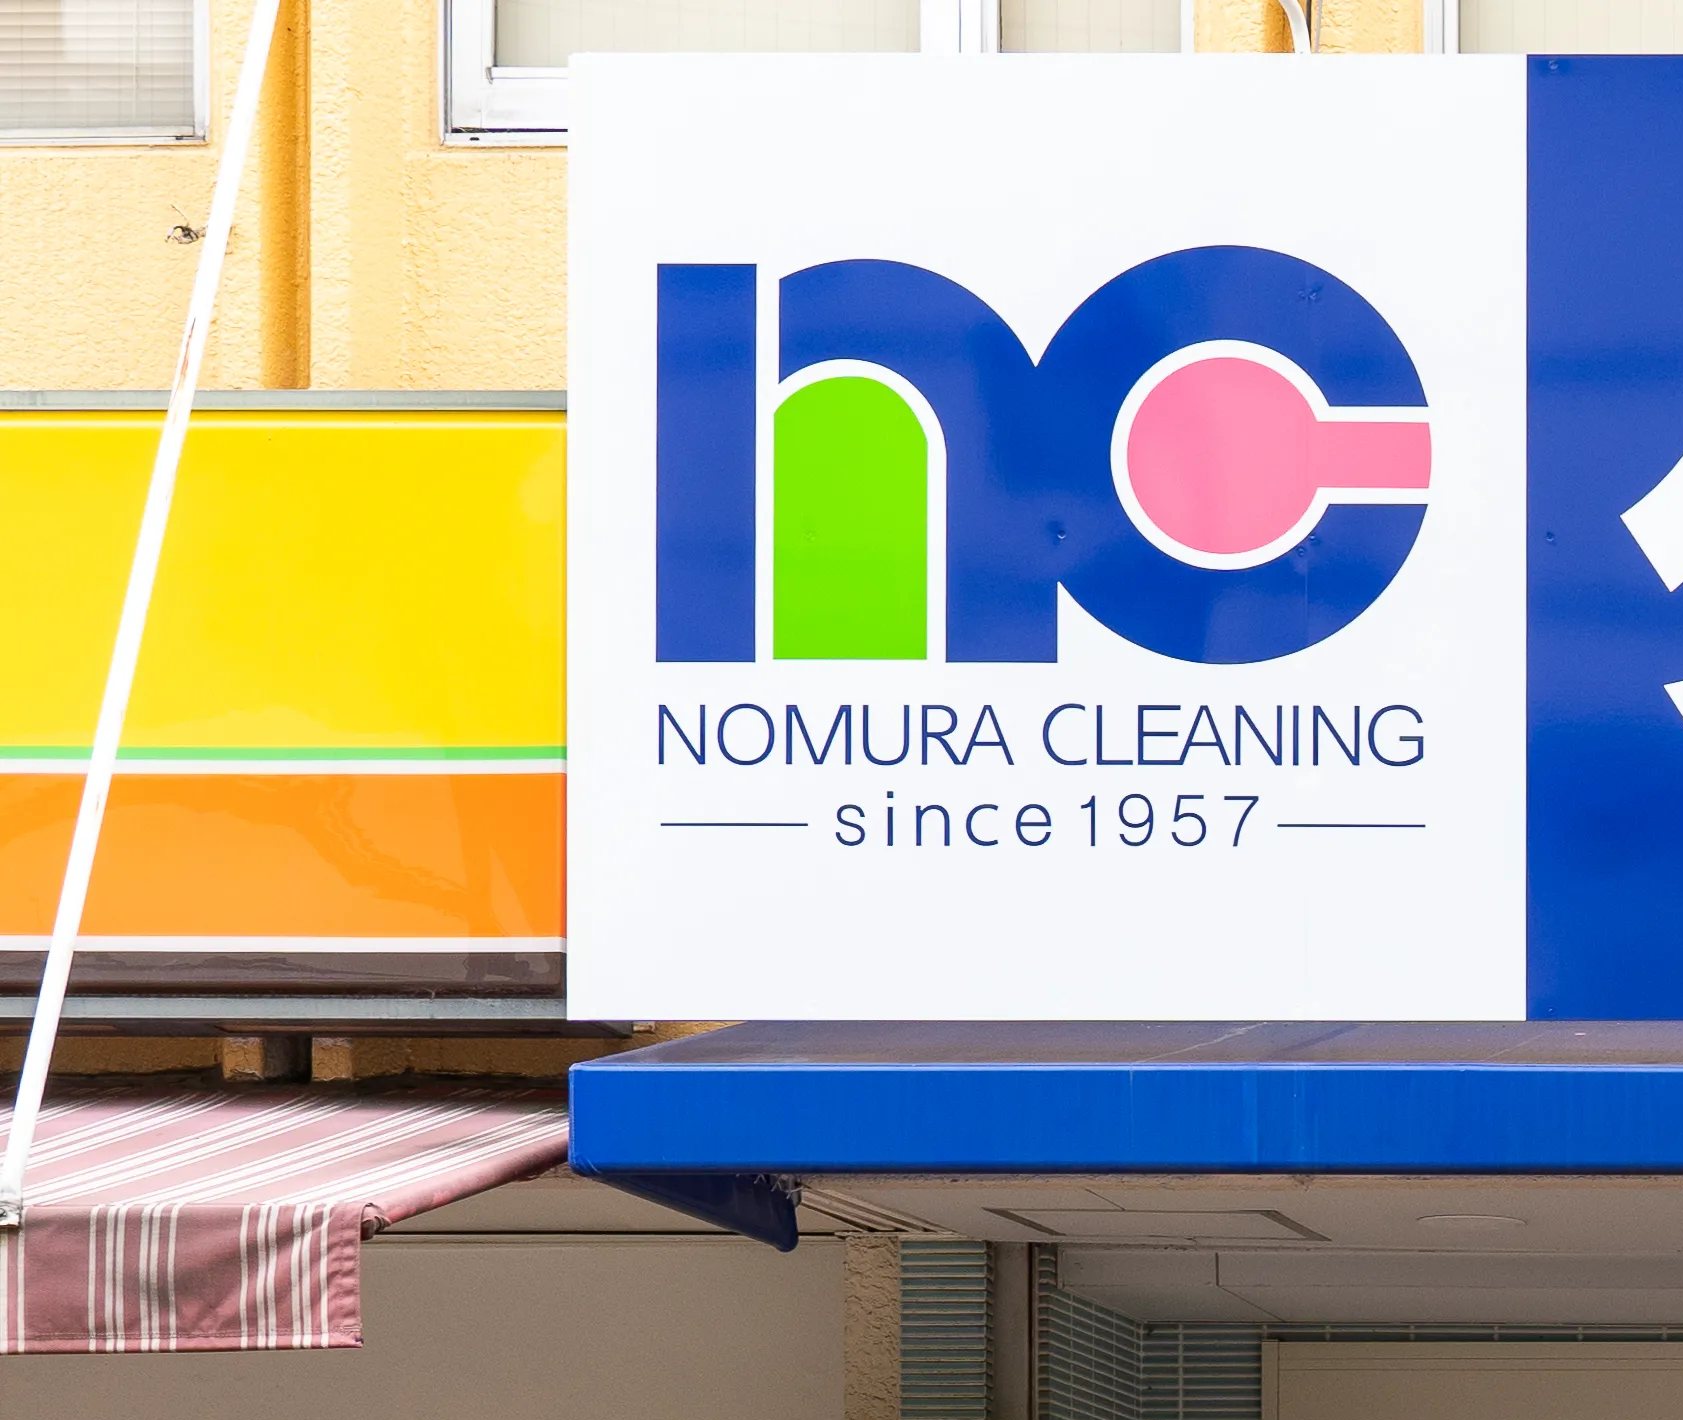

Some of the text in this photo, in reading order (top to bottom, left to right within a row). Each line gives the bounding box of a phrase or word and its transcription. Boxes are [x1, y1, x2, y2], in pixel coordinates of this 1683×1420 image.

[656, 245, 1430, 664] nc
[657, 703, 1424, 767] NOMURA CLEANING
